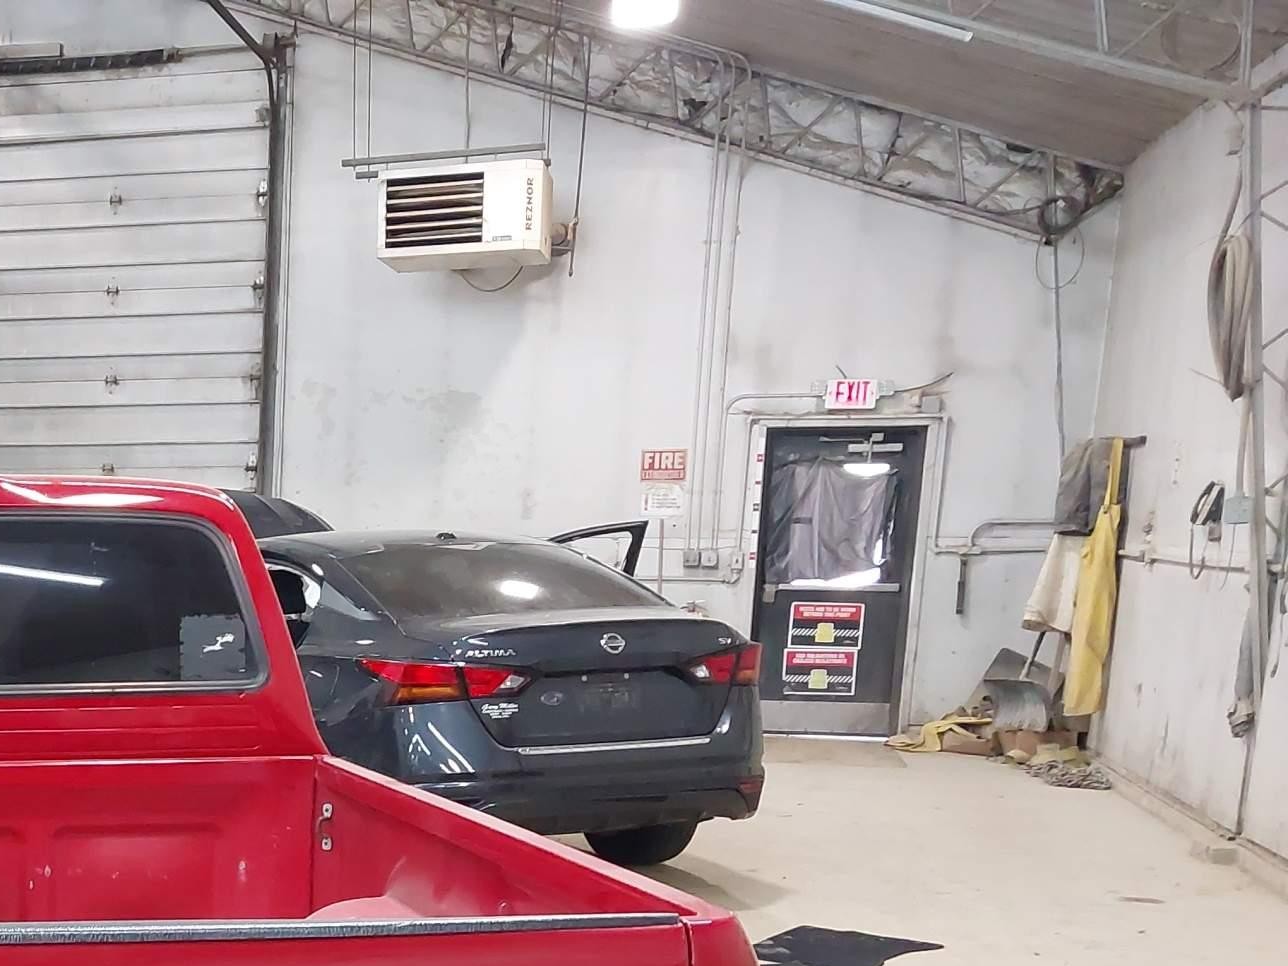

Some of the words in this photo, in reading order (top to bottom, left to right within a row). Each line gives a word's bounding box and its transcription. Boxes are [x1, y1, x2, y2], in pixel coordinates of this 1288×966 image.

[525, 177, 534, 231] REZNOR
[836, 381, 871, 405] EXIT
[644, 452, 685, 470] FIRE
[465, 648, 516, 658] ALTIMA
